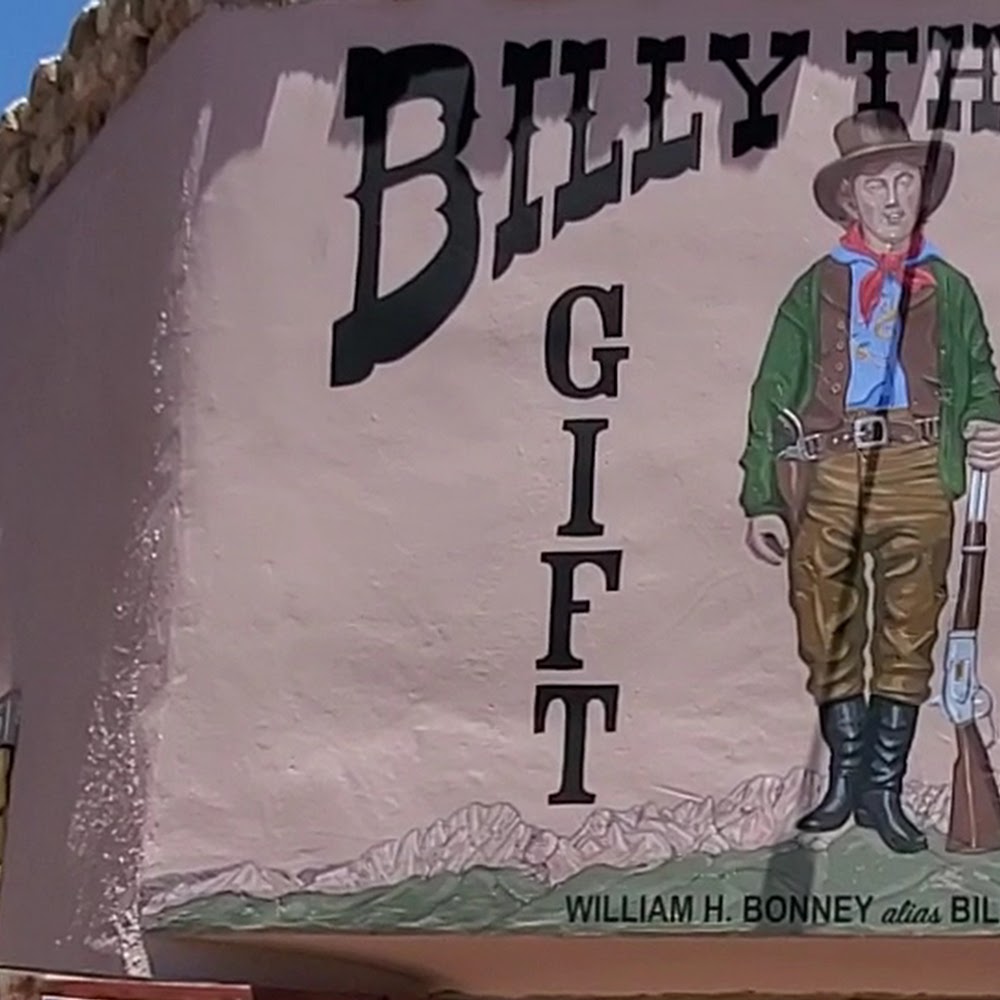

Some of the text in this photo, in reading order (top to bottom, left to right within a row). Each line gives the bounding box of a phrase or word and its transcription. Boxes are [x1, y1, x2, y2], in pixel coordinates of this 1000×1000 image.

[330, 30, 810, 387] BILLY
[533, 284, 630, 806] GIFT
[565, 894, 694, 924] WILLIAM
[703, 894, 732, 924] H.
[743, 894, 874, 924] BONNEY
[881, 899, 942, 925] alias
